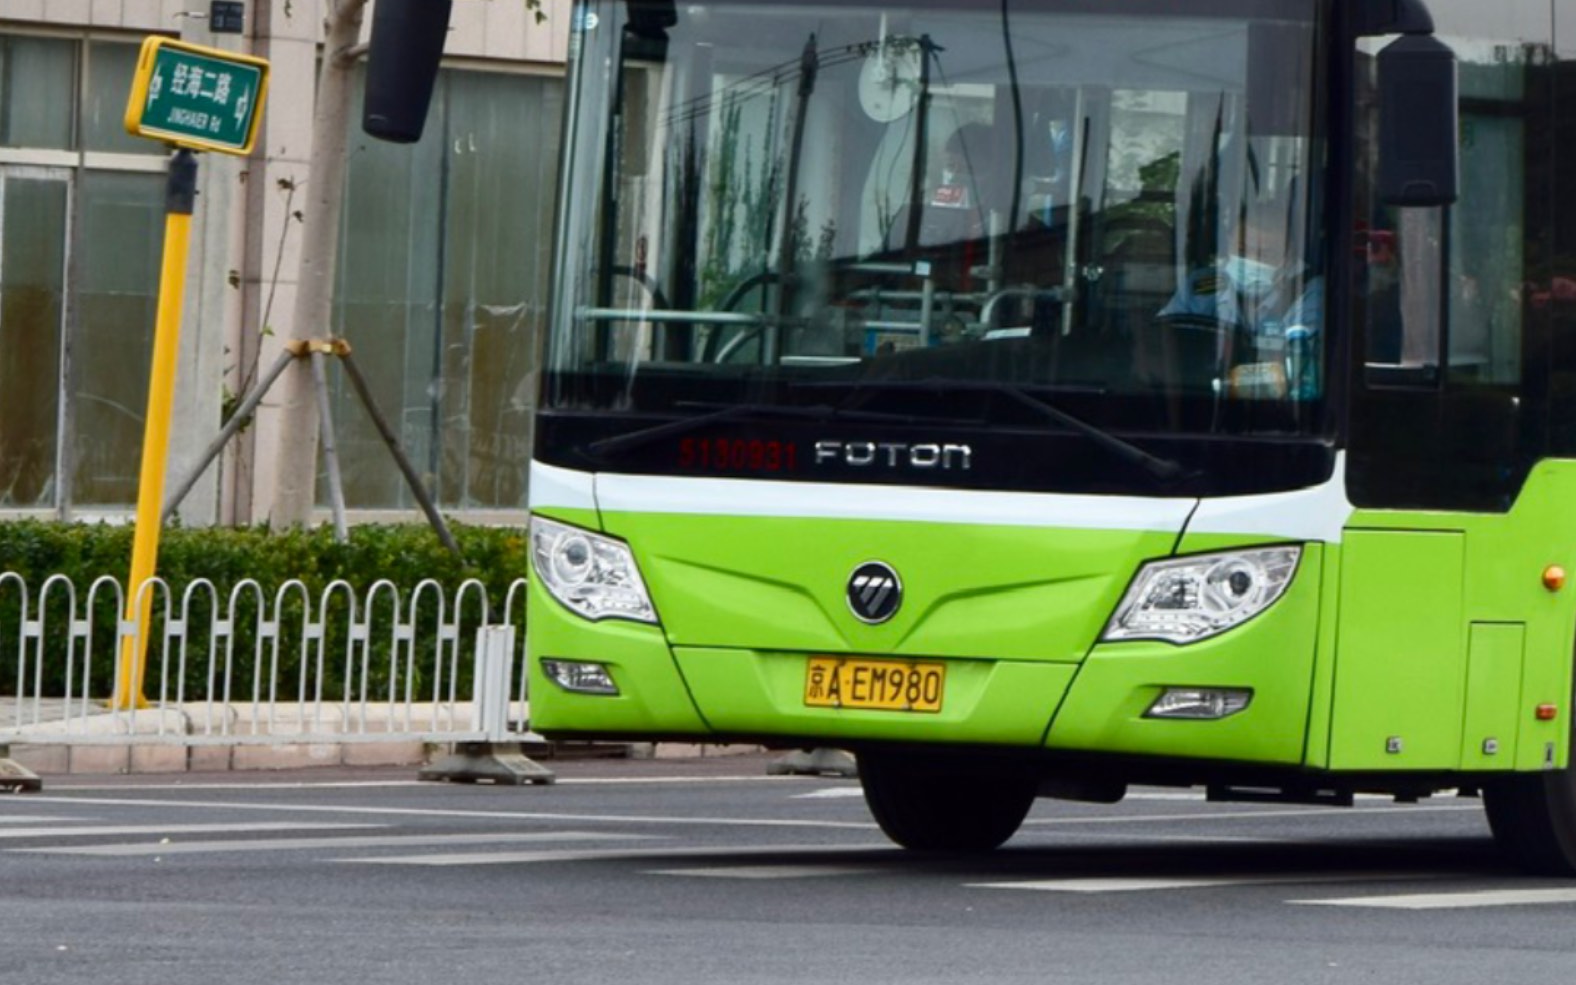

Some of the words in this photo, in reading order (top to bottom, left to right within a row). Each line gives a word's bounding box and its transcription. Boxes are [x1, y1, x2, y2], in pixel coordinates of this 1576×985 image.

[170, 63, 232, 105] 经海二路
[679, 438, 796, 469] 5130931
[815, 441, 971, 468] FOTON
